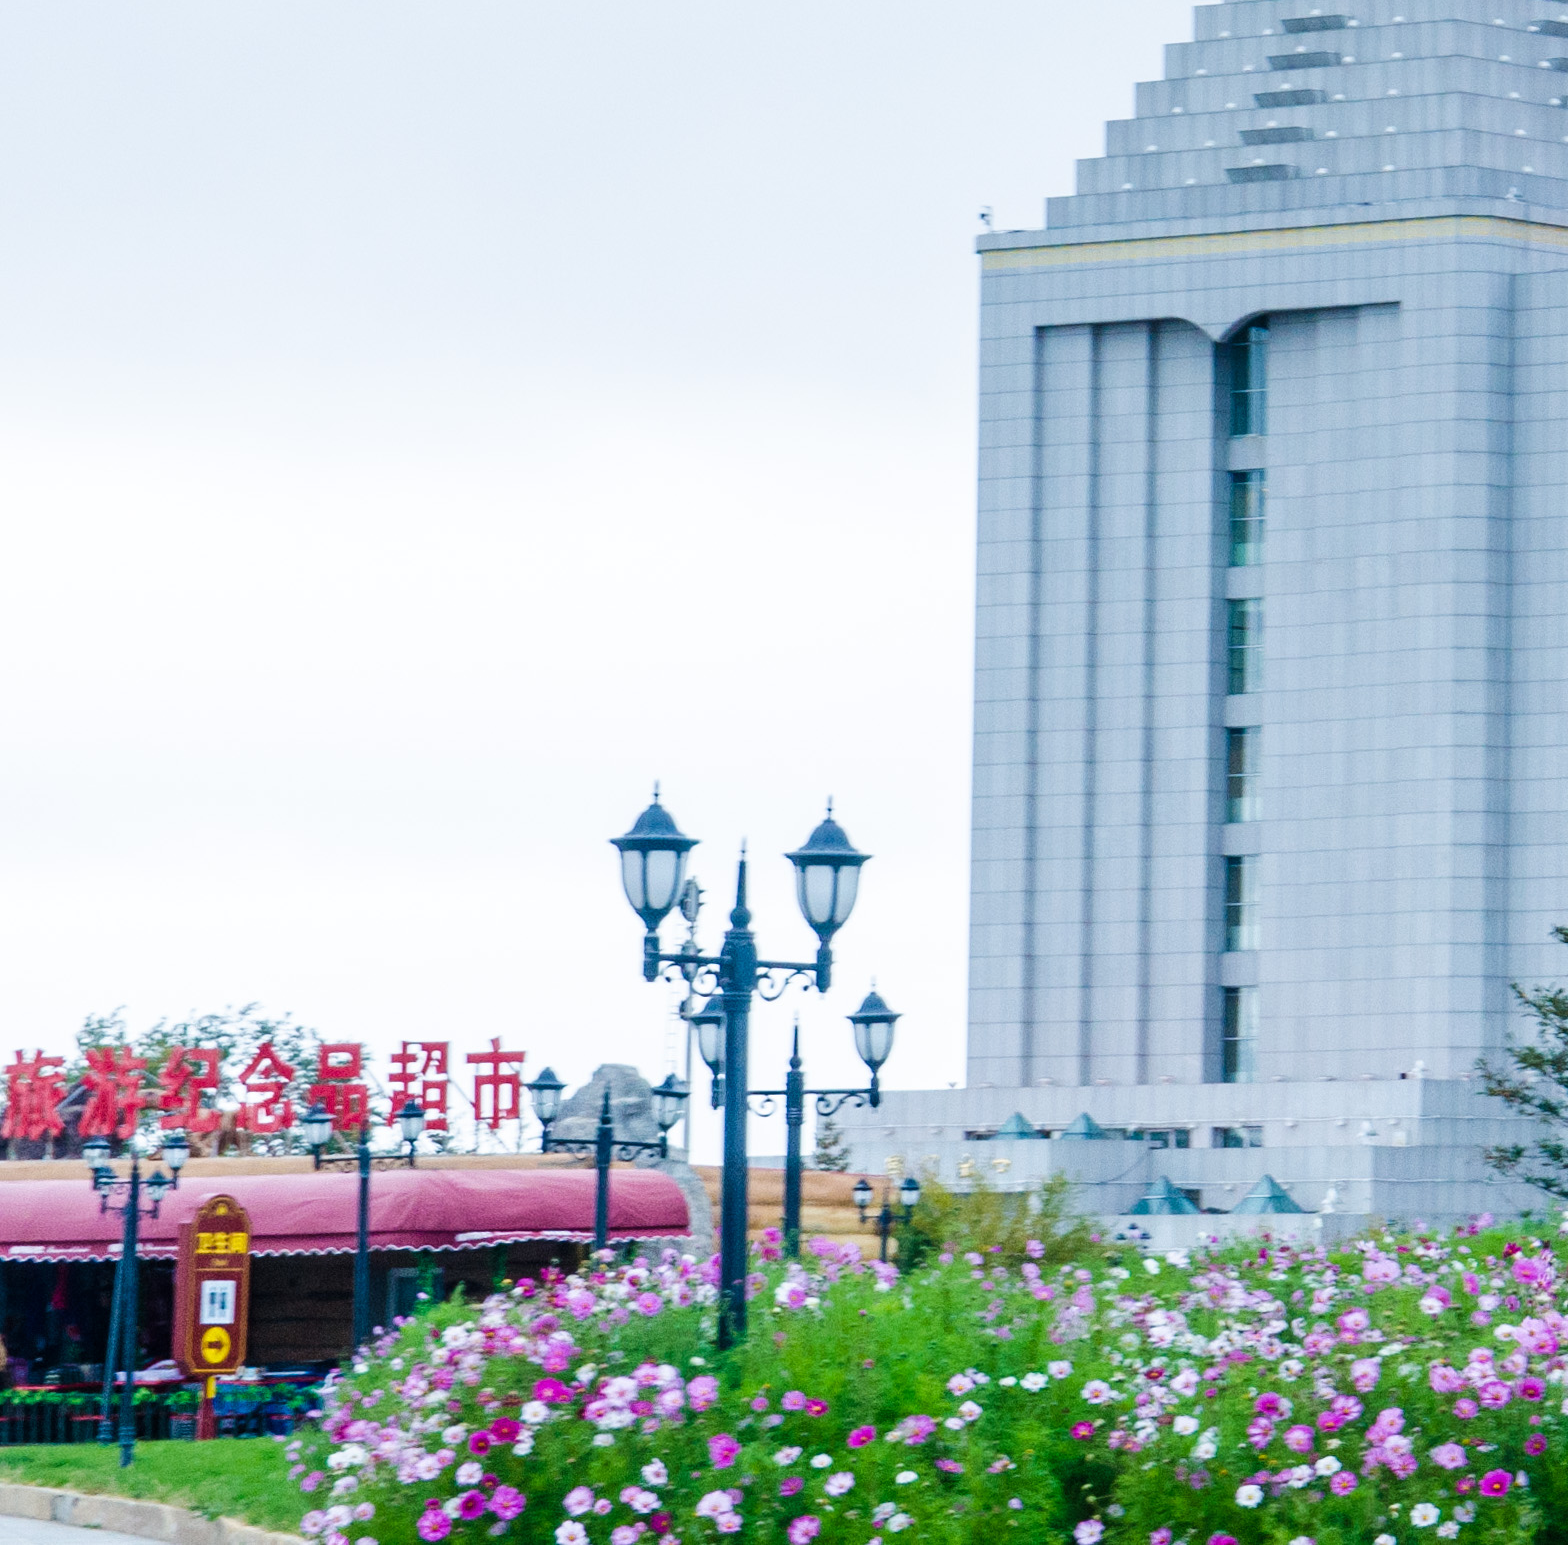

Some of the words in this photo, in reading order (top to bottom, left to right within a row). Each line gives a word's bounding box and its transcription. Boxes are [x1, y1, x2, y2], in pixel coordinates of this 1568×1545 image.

[1, 1036, 526, 1141] 旅游纪念品超市
